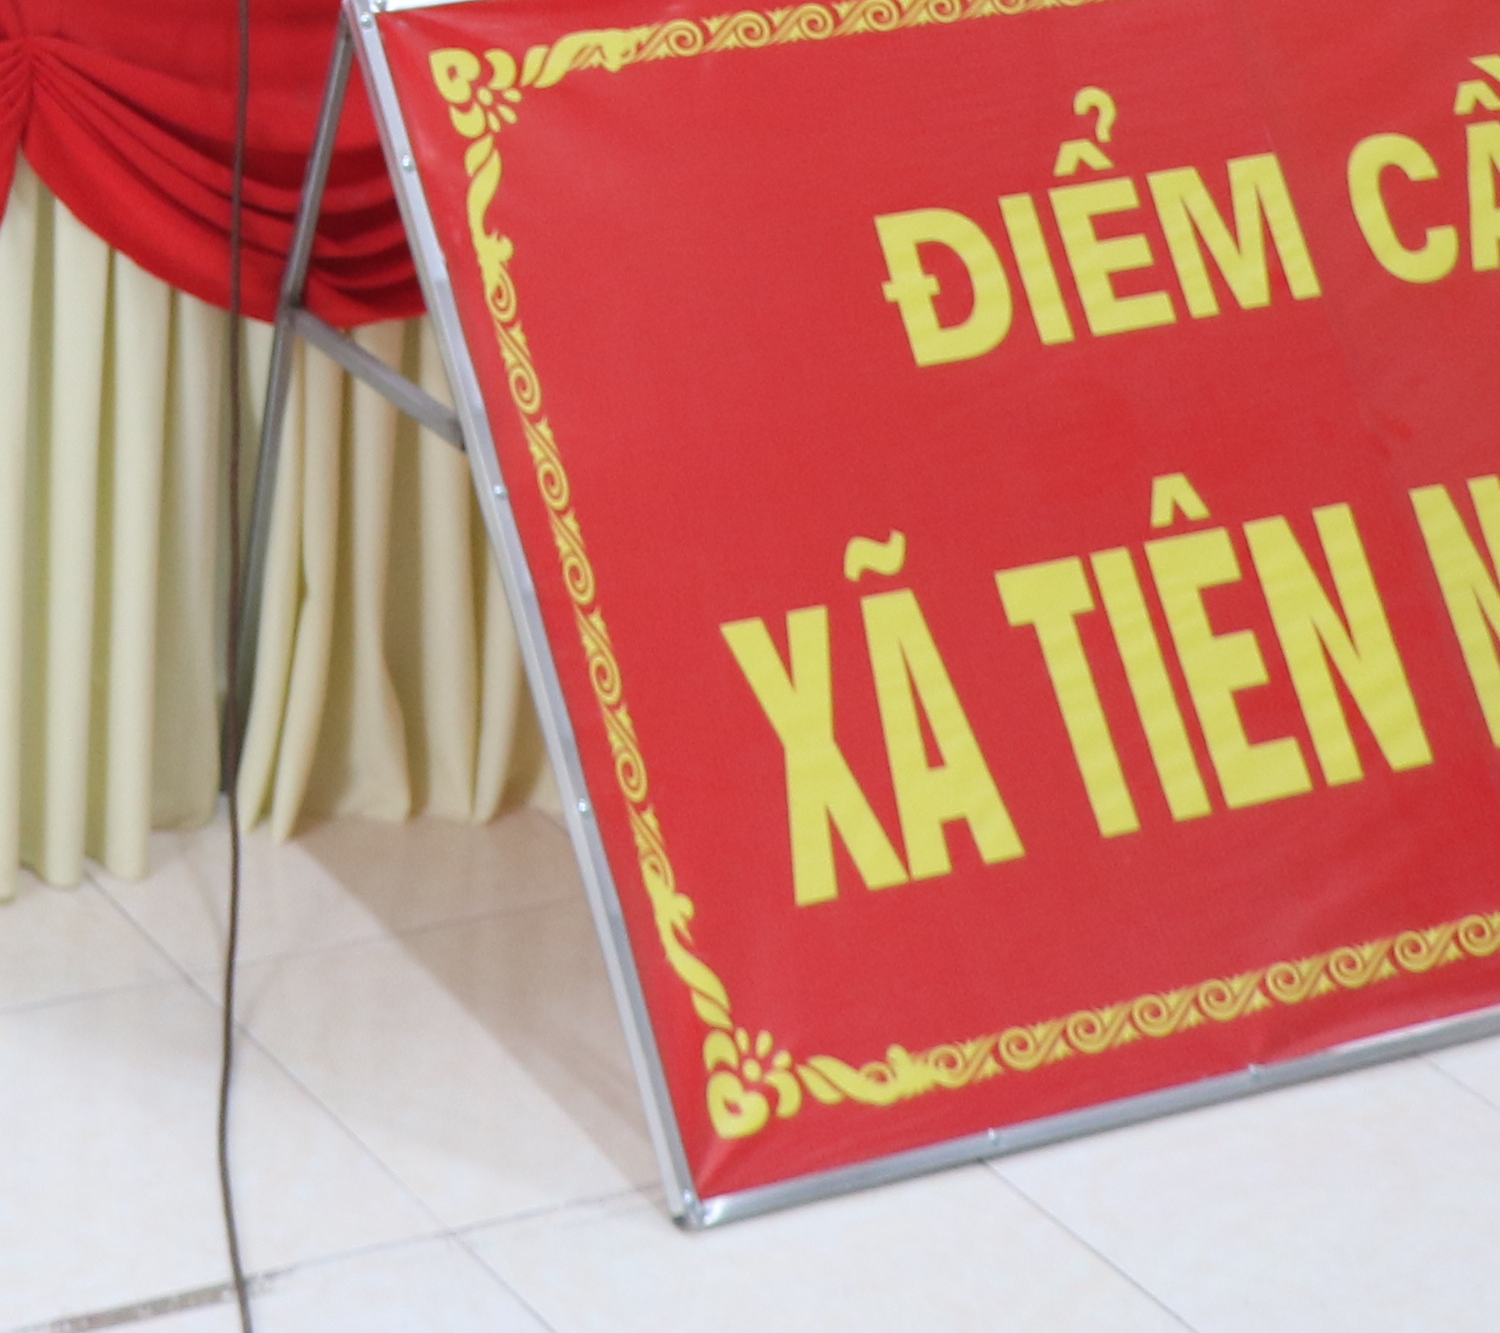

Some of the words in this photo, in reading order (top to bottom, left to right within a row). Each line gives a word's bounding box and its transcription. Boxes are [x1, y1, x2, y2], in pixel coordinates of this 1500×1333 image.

[877, 86, 1324, 369] ĐIỂM
[721, 531, 1028, 908] XÃ
[995, 473, 1436, 840] TIÊN
